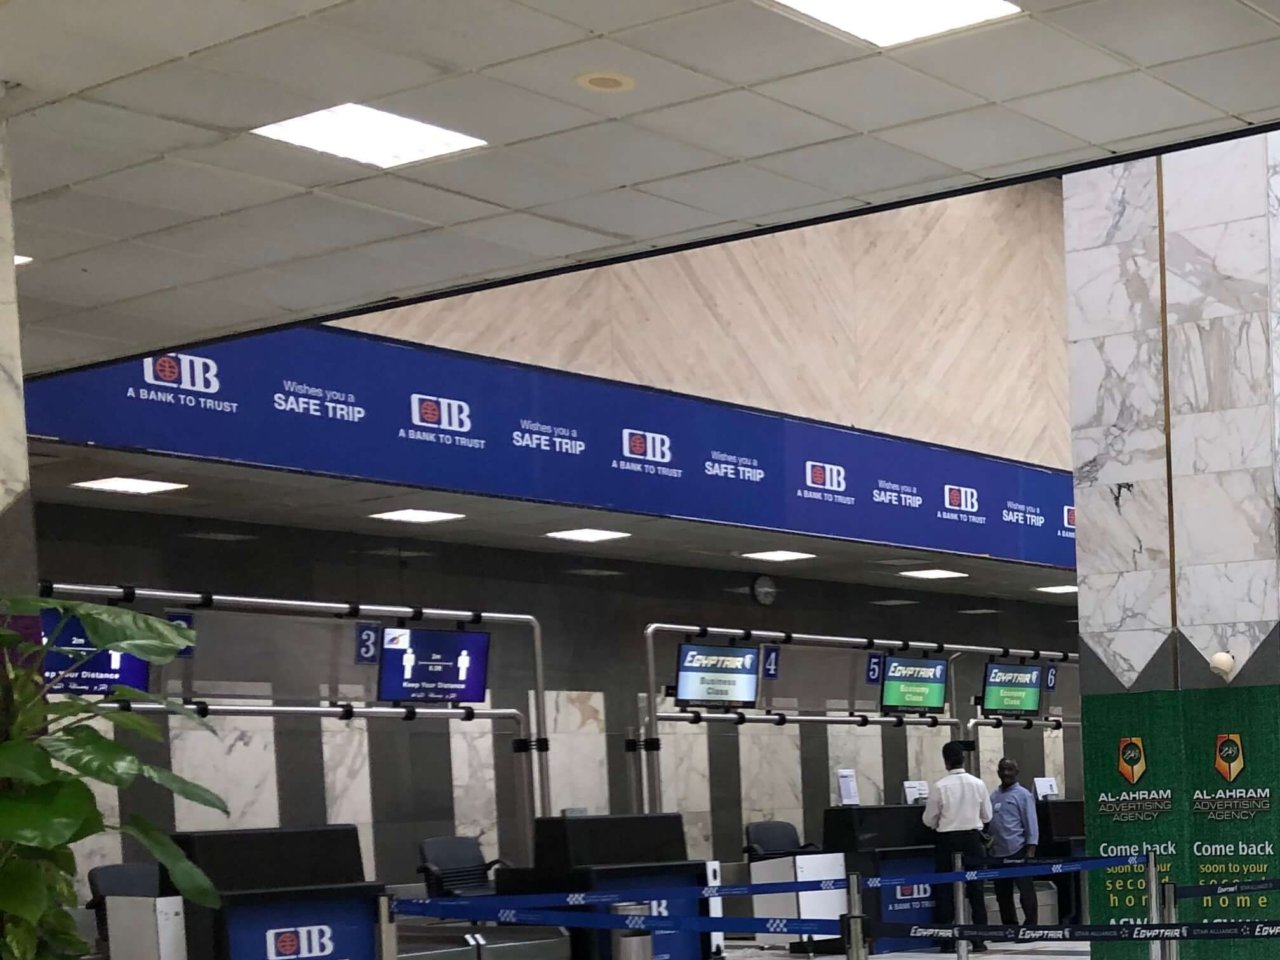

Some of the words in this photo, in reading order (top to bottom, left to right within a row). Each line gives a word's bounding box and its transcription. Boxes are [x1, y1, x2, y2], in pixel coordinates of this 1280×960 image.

[143, 353, 220, 393] CIB
[283, 380, 323, 397] Wishes
[325, 391, 346, 402] you
[347, 394, 355, 402] a
[127, 387, 136, 398] A
[139, 389, 175, 403] BANK
[178, 395, 196, 407] TO
[199, 398, 238, 413] TRUST
[273, 393, 321, 416] SAFE
[325, 402, 365, 422] TRIP
[410, 393, 471, 432] CIB
[520, 419, 552, 434] Wishes
[553, 427, 570, 437] you
[398, 429, 406, 437] A
[408, 430, 437, 443] BANK
[438, 434, 452, 444] TO
[454, 436, 486, 449] TRUST
[512, 431, 550, 450] SAFE
[553, 437, 586, 455] TRIP
[622, 429, 671, 462] CIB
[711, 450, 737, 463] Wishes
[738, 456, 751, 467] you
[752, 459, 758, 467] a
[611, 460, 618, 468] A
[619, 460, 643, 472] BANK
[644, 464, 656, 475] TO
[657, 466, 683, 478] TRUST
[704, 461, 736, 478] SAFE
[737, 466, 765, 482] TRIP
[805, 461, 846, 492] CIB
[796, 489, 803, 497] A
[803, 489, 823, 500] BANK
[823, 492, 833, 502] TO
[834, 494, 855, 505] TRUST
[872, 489, 899, 505] SAFE
[899, 494, 923, 508] TRIP
[944, 484, 979, 512] CIB
[942, 511, 959, 520] BANK
[959, 513, 968, 522] TO
[968, 514, 986, 524] TRUST
[1002, 509, 1024, 524] SAFE
[1025, 513, 1045, 527] TRIP
[360, 630, 376, 658] 3
[683, 650, 744, 669] EGYPTAIR
[765, 652, 777, 674] 4
[81, 671, 120, 679] Distance
[869, 658, 879, 679] 5
[888, 662, 935, 679] EGYPTAIR
[989, 669, 1031, 684] EGYPTAIR
[402, 681, 420, 689] Keep
[700, 677, 736, 685] Business
[1047, 669, 1055, 686] 6
[706, 687, 729, 696] Class
[900, 685, 929, 695] Economy
[904, 694, 923, 702] Class
[1000, 689, 1026, 698] Economy
[1004, 697, 1020, 706] Class
[1098, 789, 1171, 802] AL-AHRAM
[1193, 788, 1270, 799] AL-AHRAM
[1099, 800, 1172, 812] ADVERTISING
[1193, 799, 1270, 810] ADVERTISING
[1113, 811, 1159, 822] AGENCY
[1207, 810, 1256, 820] AGENCY
[1100, 842, 1139, 857] Come
[1193, 841, 1235, 856] Come
[1238, 841, 1274, 856] back
[1133, 862, 1144, 873] to
[1200, 863, 1226, 873] soon
[1228, 862, 1240, 873] to
[1242, 863, 1268, 875] your
[910, 926, 953, 938] EGYPTAIR
[1018, 927, 1063, 939] EGYPTAIR
[1132, 927, 1181, 939] EGYPTAIR
[265, 925, 334, 960] CIB
